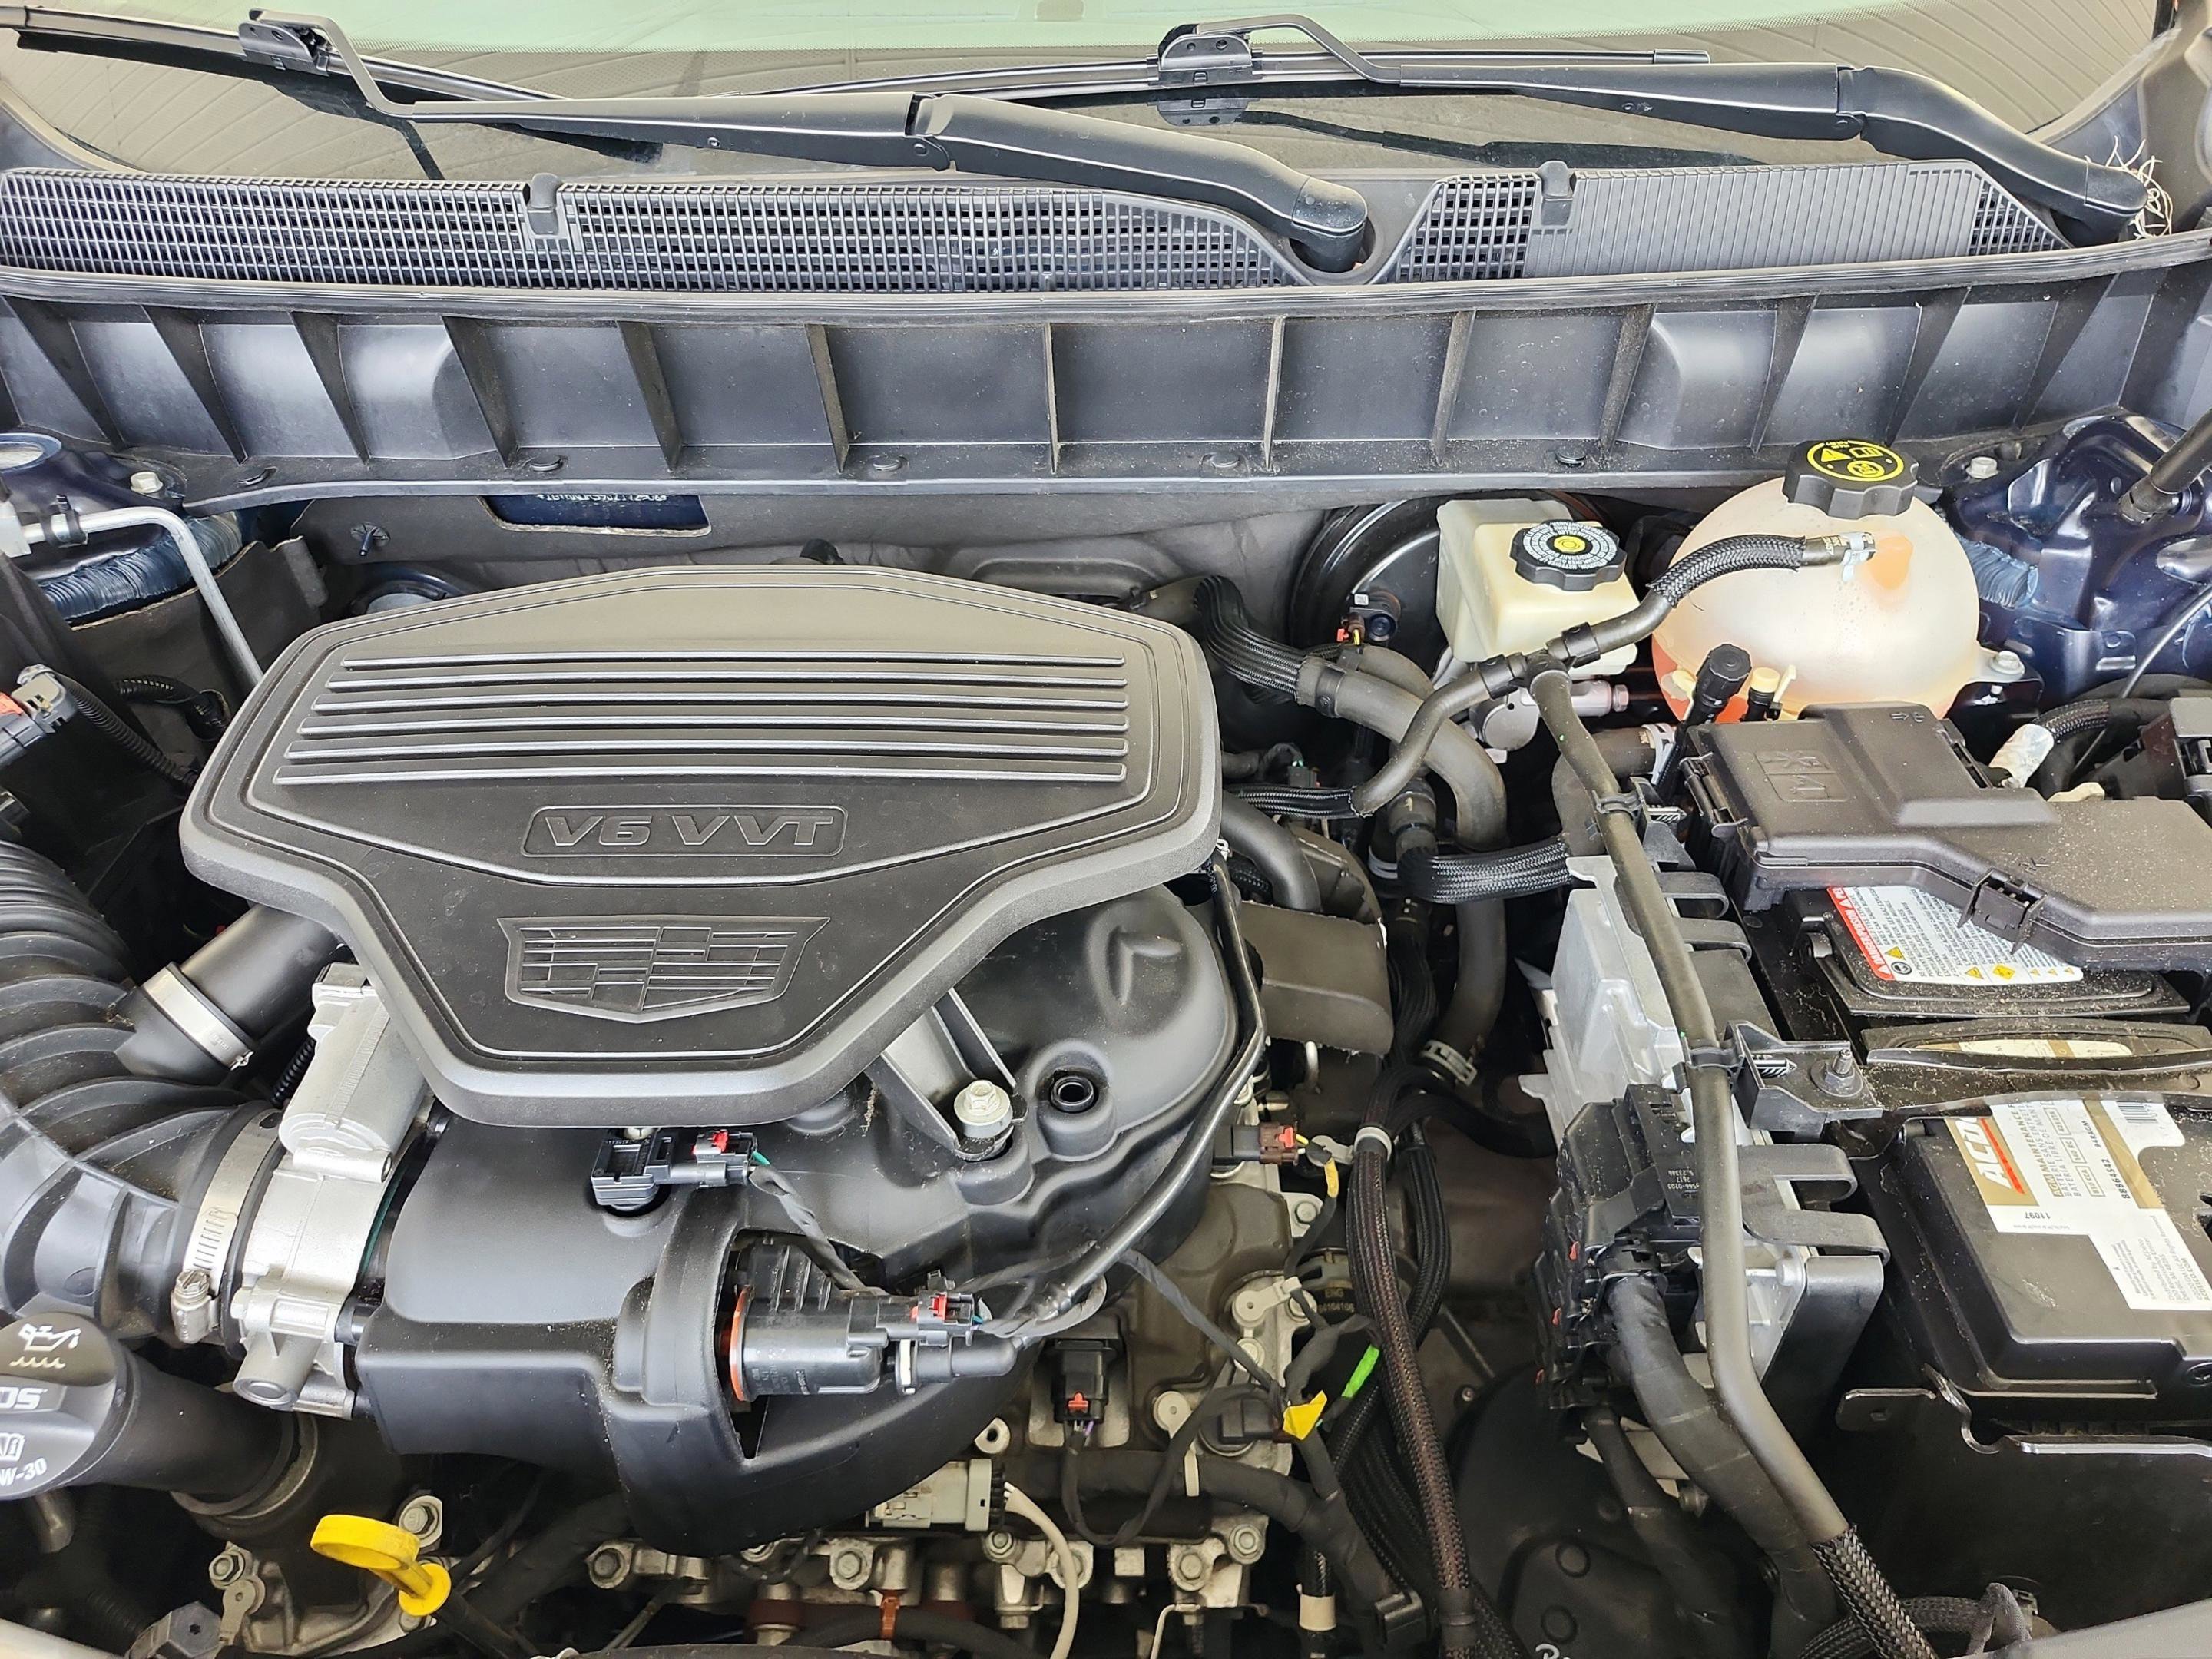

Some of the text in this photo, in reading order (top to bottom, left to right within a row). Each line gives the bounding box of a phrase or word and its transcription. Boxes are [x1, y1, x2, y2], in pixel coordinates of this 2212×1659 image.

[545, 815, 833, 846] V6 VVT
[1841, 909, 1886, 964] DANGER/POISON
[2034, 1138, 2051, 1157] SANS
[2038, 1128, 2050, 1137] DE
[2081, 1120, 2101, 1147] 94RAGM
[2010, 1111, 2062, 1197] AGM MAINTENANCE
[2045, 1158, 2072, 1196] BATTERIE
[2101, 1158, 2130, 1198] 88864542
[2136, 1238, 2153, 1260] ACDelco
[2180, 1257, 2210, 1300] ACDELCO.COM
